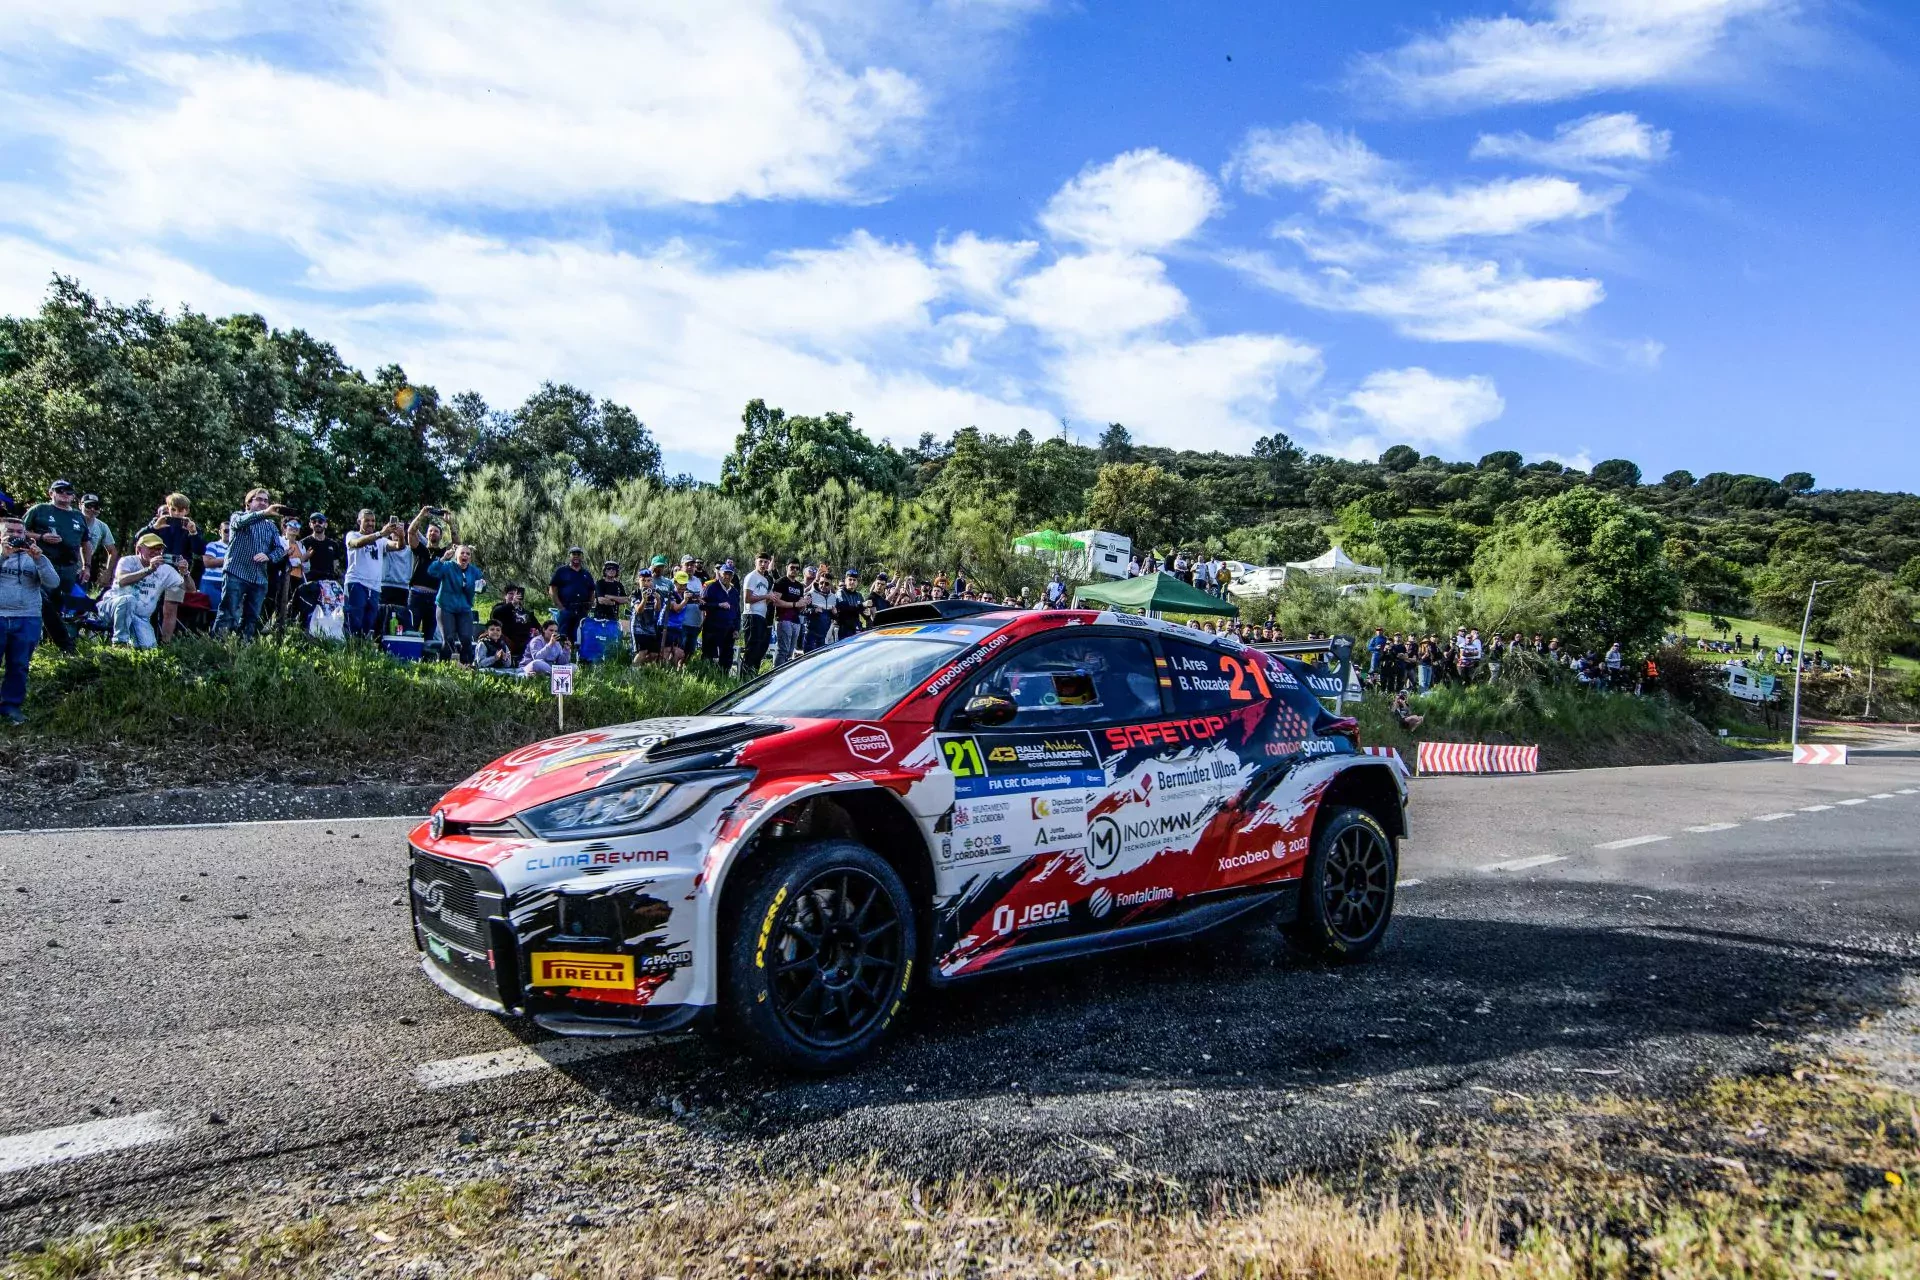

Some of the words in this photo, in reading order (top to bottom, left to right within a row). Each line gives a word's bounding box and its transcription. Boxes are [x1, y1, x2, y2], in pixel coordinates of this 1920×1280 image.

[927, 634, 1009, 696] grupobreogan.com
[1182, 657, 1209, 671] Ares
[1179, 676, 1193, 691] B.
[1194, 676, 1230, 691] Rozada
[1219, 655, 1273, 700] 21
[1263, 668, 1299, 685] texas
[850, 734, 886, 744] SEGURO
[1105, 716, 1224, 751] SAFETOP
[853, 742, 888, 751] TOYOTA
[988, 746, 1018, 762] 43
[1015, 744, 1045, 754] RALLY
[944, 739, 984, 777] 21
[1018, 752, 1053, 761] SIERRA
[1053, 750, 1093, 759] MORENA
[989, 779, 1004, 790] FIA
[1005, 777, 1021, 789] ERC
[1021, 774, 1071, 787] Championship
[1157, 765, 1211, 791] Bermúdez
[1210, 760, 1237, 780] Ulloa
[1051, 797, 1083, 807] Diputación
[1053, 807, 1060, 815] de
[1050, 826, 1065, 834] Junta
[1124, 811, 1191, 842] INOXMAN
[1050, 834, 1057, 842] de
[526, 853, 589, 871] CLIMA
[593, 850, 669, 864] REYMA
[1218, 849, 1270, 872] Xacobeo
[1288, 836, 1309, 852] 2027
[1116, 887, 1174, 907] Fontalclima
[653, 951, 692, 964] PAGID
[543, 959, 625, 982] PIRELLI
